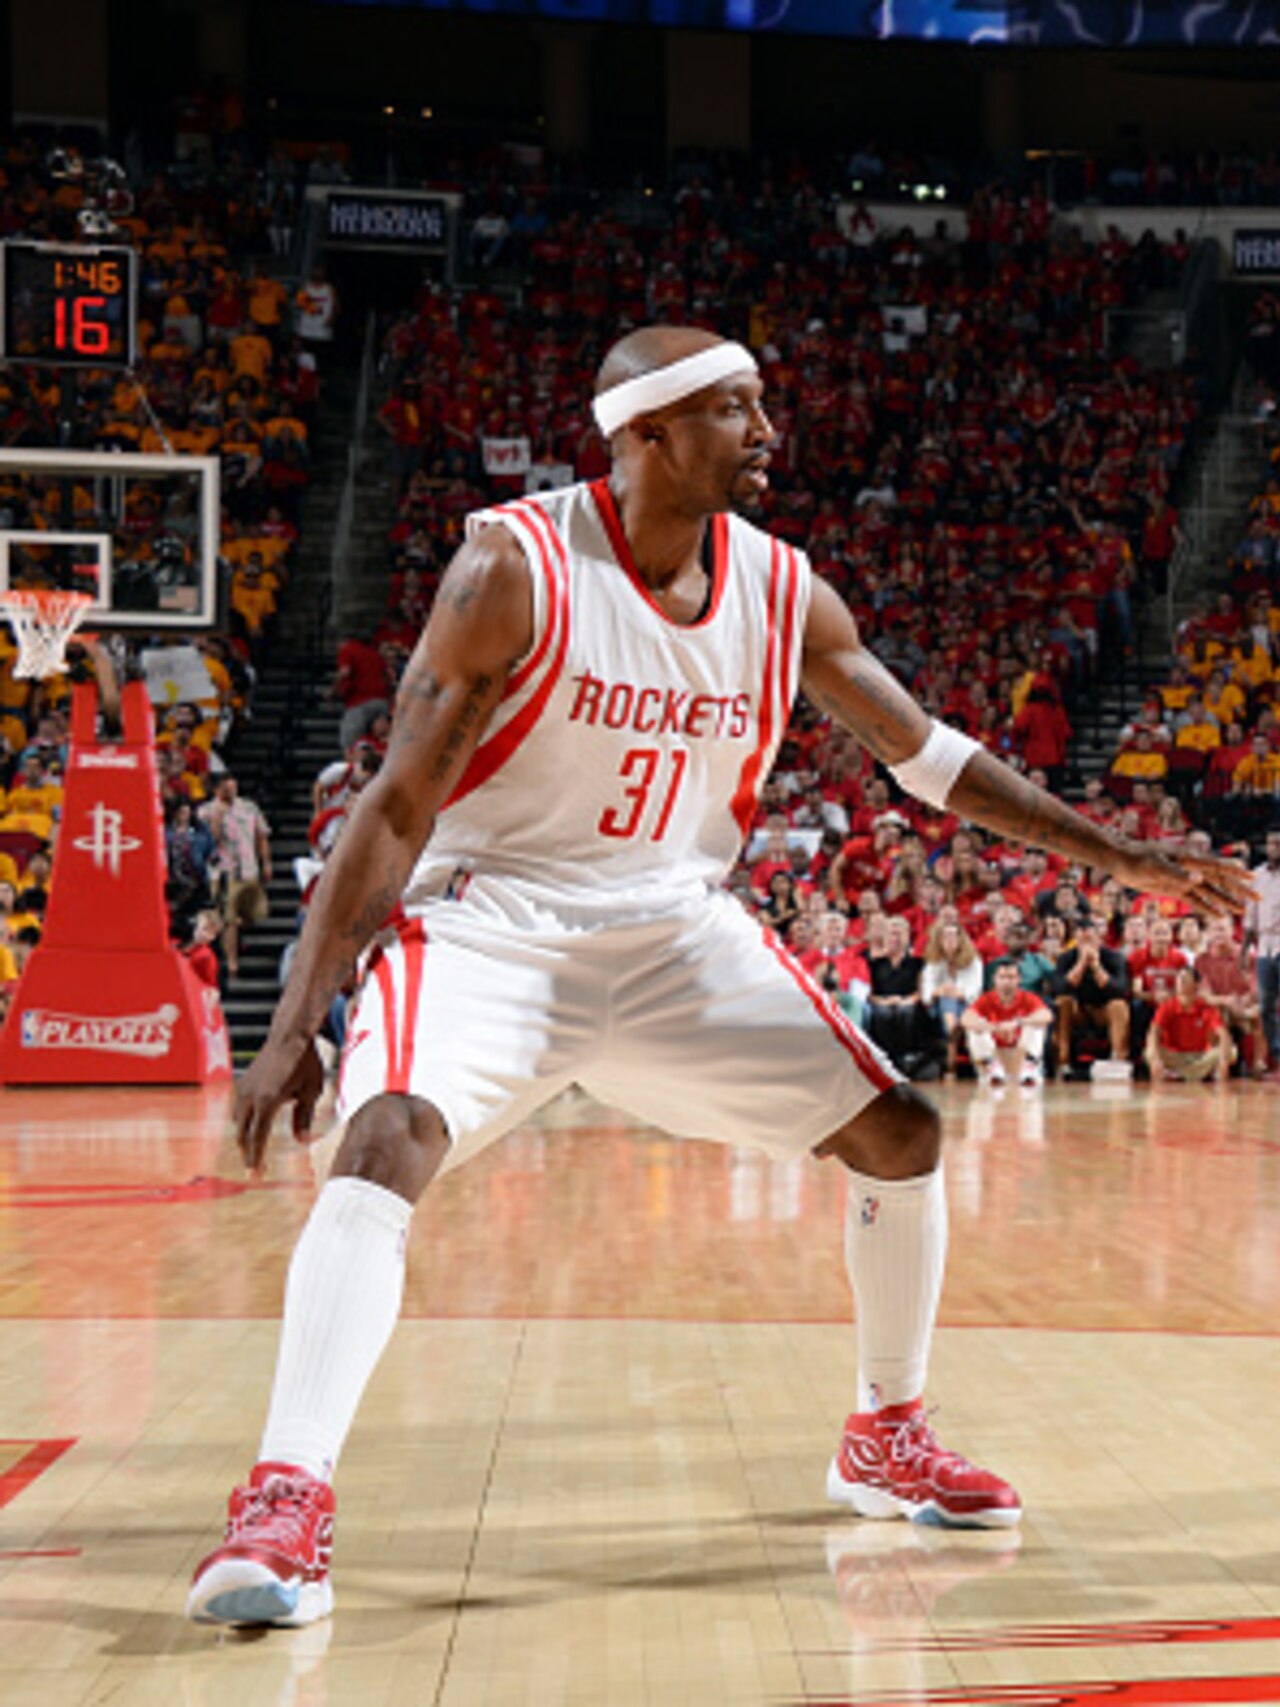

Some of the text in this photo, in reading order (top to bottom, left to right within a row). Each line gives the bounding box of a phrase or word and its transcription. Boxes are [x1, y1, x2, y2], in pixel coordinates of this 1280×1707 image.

[54, 261, 121, 294] 1:46
[54, 296, 109, 354] 16
[569, 667, 751, 738] ROCKETS
[598, 748, 687, 842] 31
[42, 1019, 173, 1044] PLAYOFFS
